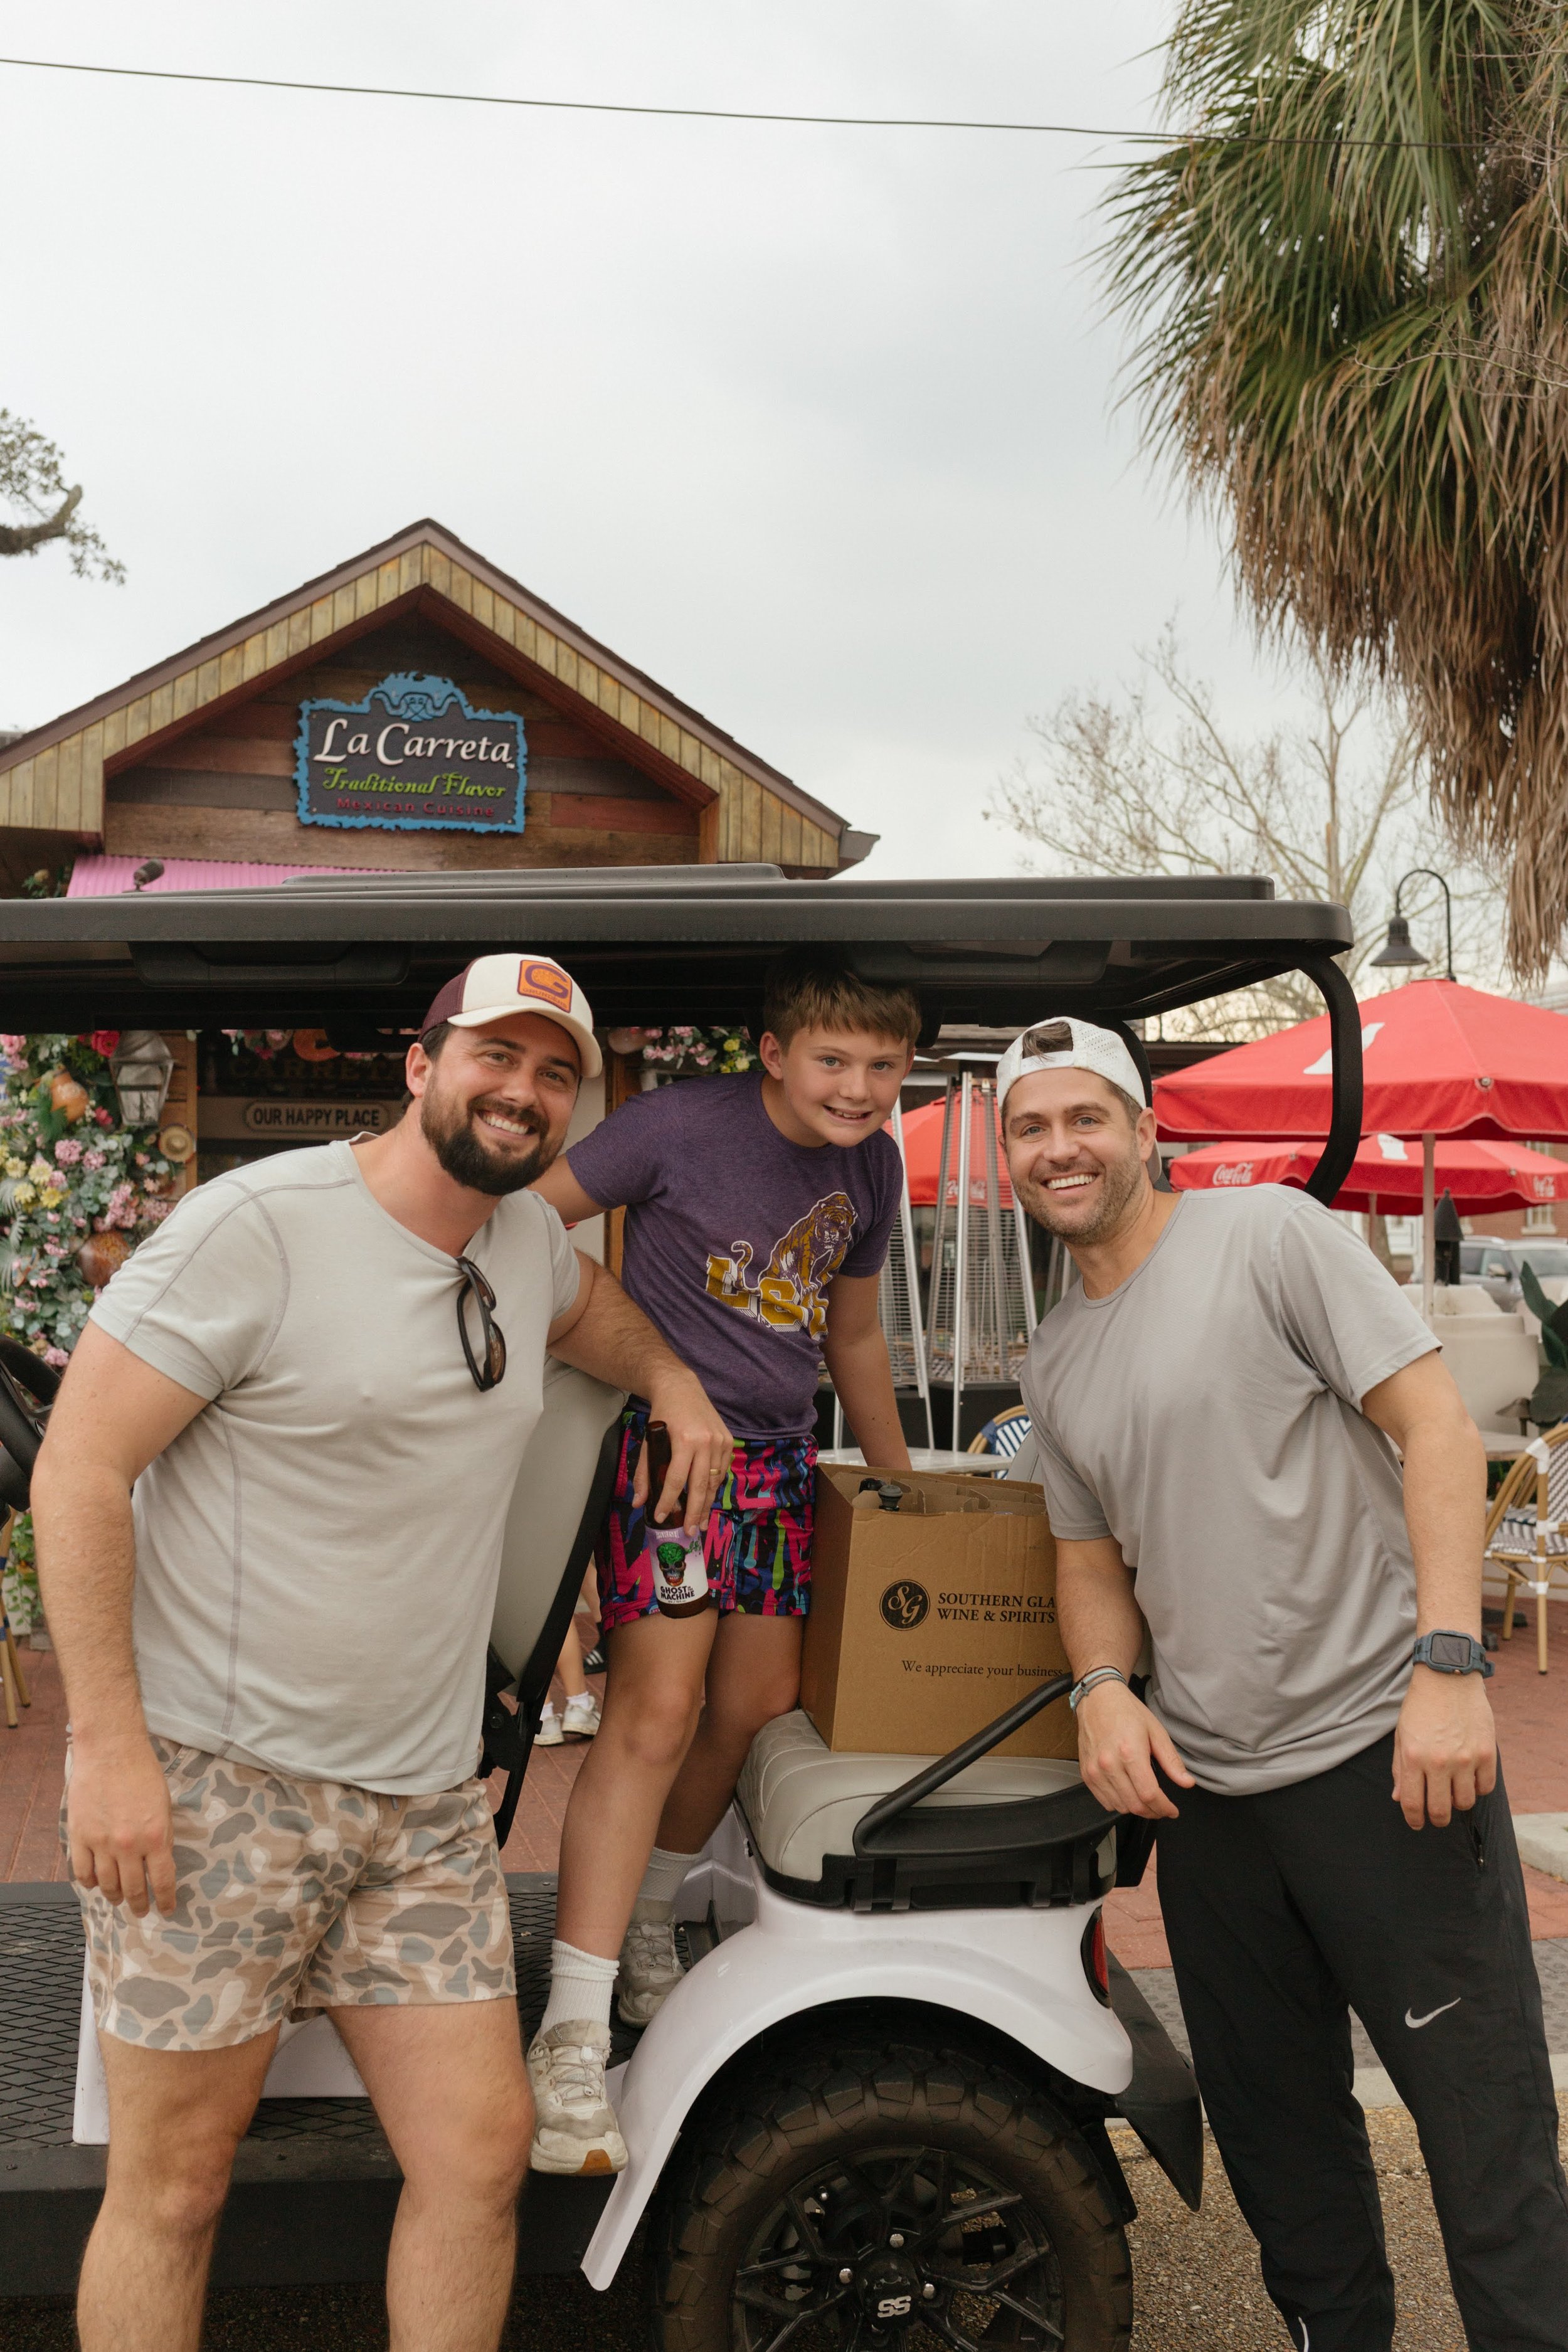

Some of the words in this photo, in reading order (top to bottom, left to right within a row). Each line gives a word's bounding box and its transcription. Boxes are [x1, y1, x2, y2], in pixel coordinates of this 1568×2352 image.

[314, 718, 371, 763] La
[376, 723, 512, 765] Carreta
[322, 766, 439, 795] Traditional
[441, 771, 506, 798] Flavor
[337, 797, 415, 813] Mexican
[423, 800, 494, 817] Cuisine
[254, 1108, 282, 1125] OUR
[286, 1108, 332, 1126] HAPPY
[336, 1109, 379, 1126] PLACE
[660, 1585, 687, 1594] GHOST
[660, 1590, 695, 1601] MACHINE
[938, 1592, 1024, 1608] SOUTHERN
[1027, 1594, 1055, 1609] GLA
[937, 1608, 979, 1622] WINE
[983, 1610, 997, 1622] &
[999, 1610, 1055, 1624] SPIRITS
[902, 1660, 922, 1673] We
[925, 1663, 983, 1677] appreciate
[987, 1665, 1014, 1678] your
[1017, 1664, 1063, 1677] business
[877, 2295, 911, 2318] SS
